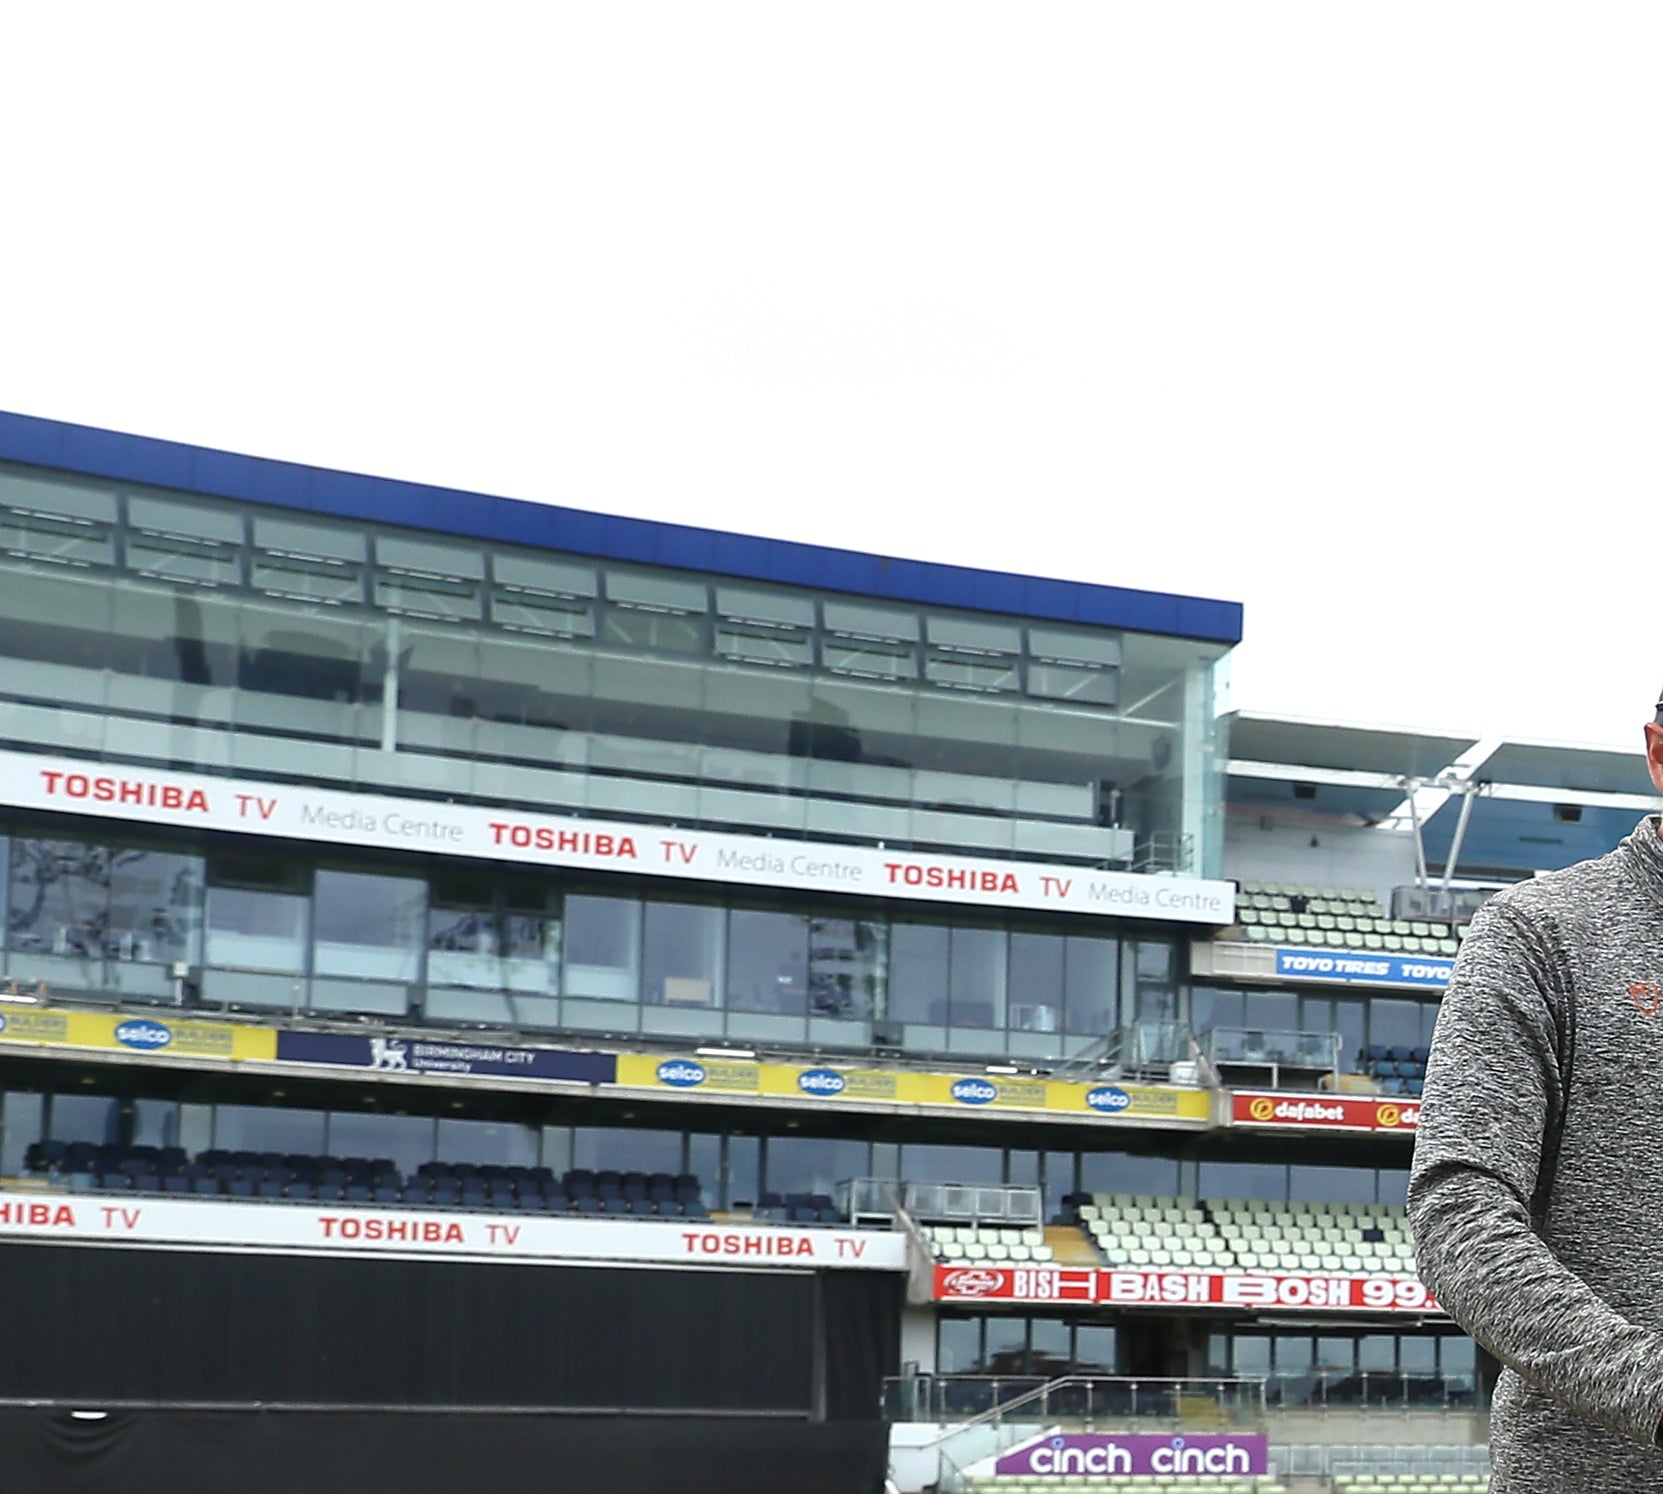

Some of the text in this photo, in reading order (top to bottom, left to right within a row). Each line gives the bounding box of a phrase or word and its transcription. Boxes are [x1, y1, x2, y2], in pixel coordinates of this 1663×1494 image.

[40, 771, 465, 843] TOSHIBA TV Media Centre
[488, 823, 863, 882] TOSHIBA TV Media Centre
[884, 863, 1222, 912] TOSHIBA TV Media Centre
[1282, 956, 1391, 976] TOYO TIRES
[1402, 964, 1450, 980] TOYO
[117, 1027, 169, 1043] selco
[504, 1051, 536, 1064] CITY
[658, 1065, 704, 1082] selco
[800, 1074, 843, 1090] selco
[952, 1083, 996, 1100] selco
[1087, 1092, 1130, 1108] selco
[1274, 1100, 1344, 1122] dafabet
[0, 1203, 141, 1230] HIBA TV
[319, 1216, 522, 1246] TOSHIBA TV
[682, 1233, 867, 1258] TOSHIBA TV
[1013, 1271, 1097, 1299] BISH
[1110, 1274, 1210, 1304] BASH
[1222, 1275, 1350, 1307] BOSH
[1362, 1280, 1441, 1308] 99.
[1029, 1437, 1250, 1474] cinch cinch
